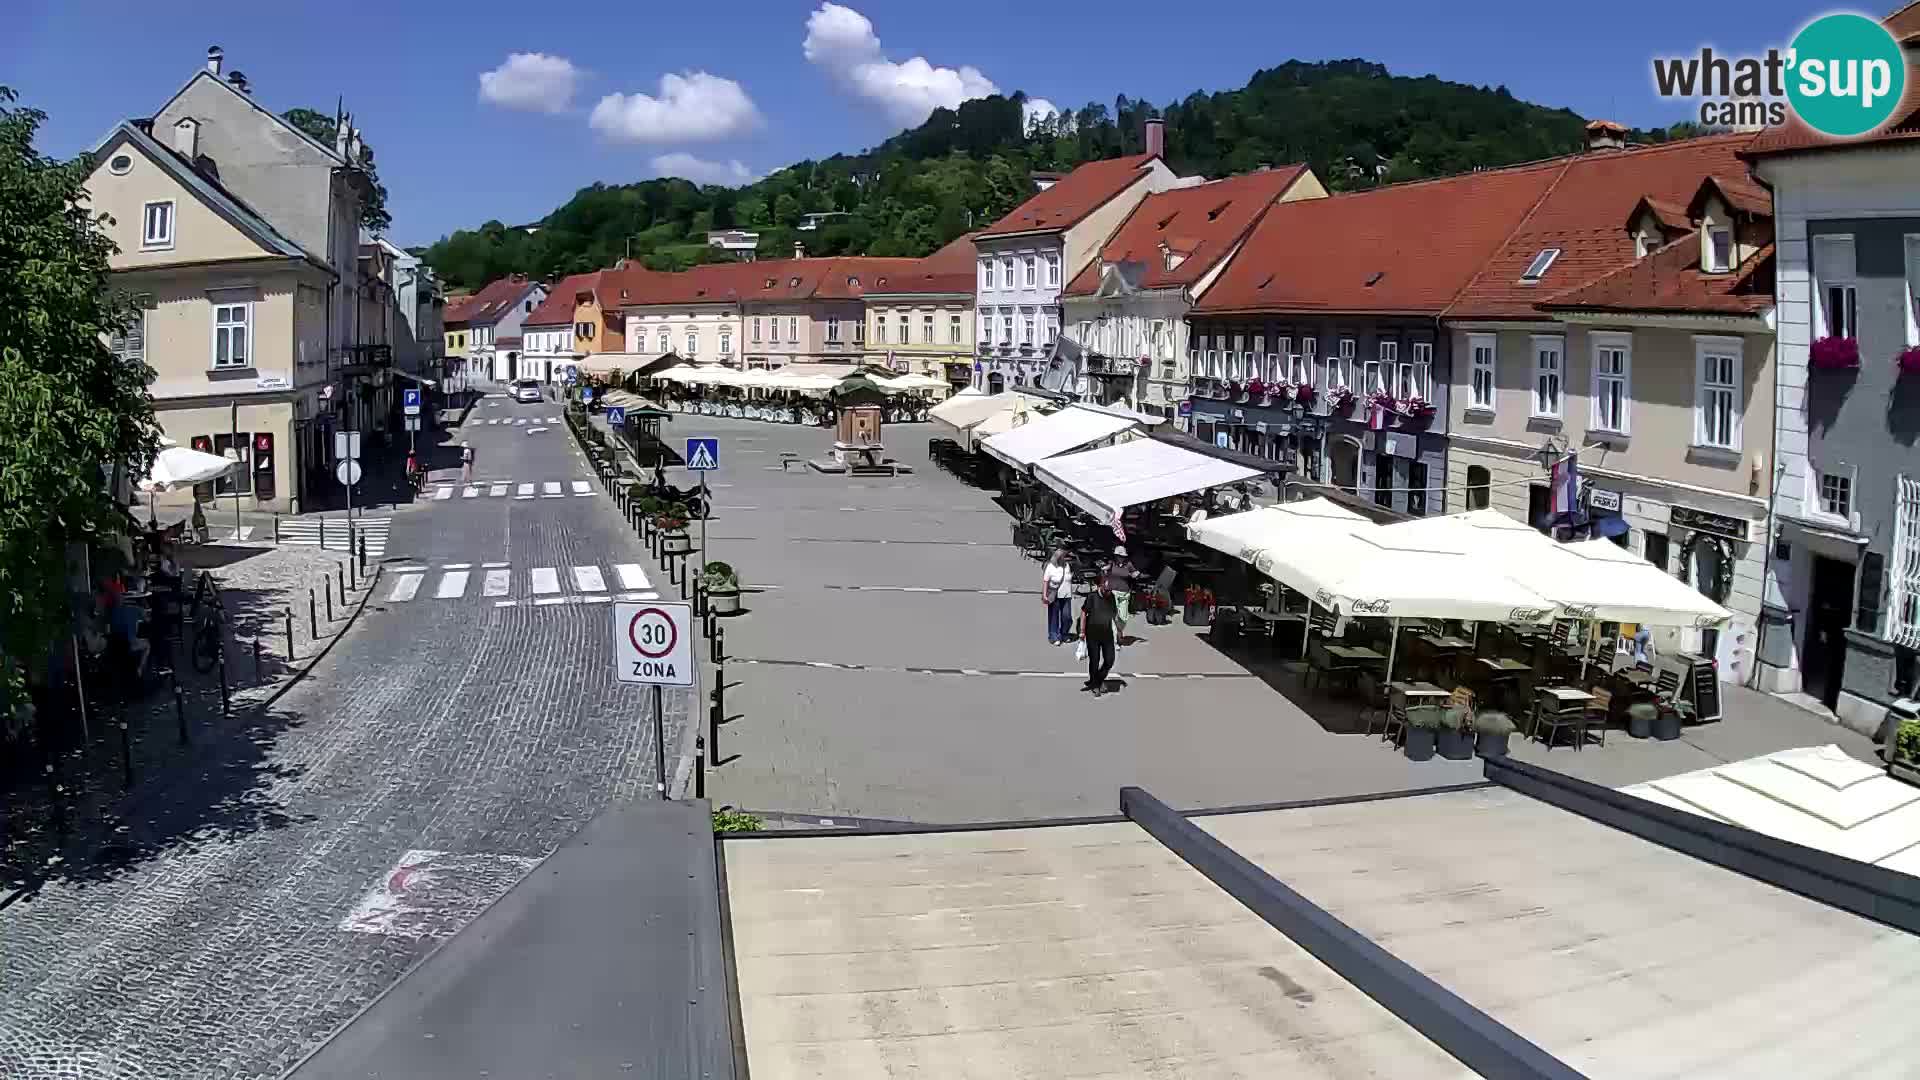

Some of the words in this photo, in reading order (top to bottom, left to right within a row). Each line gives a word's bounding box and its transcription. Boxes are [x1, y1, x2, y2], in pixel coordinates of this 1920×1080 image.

[408, 392, 416, 403] P
[641, 623, 666, 645] 30
[632, 661, 677, 678] ZONA
